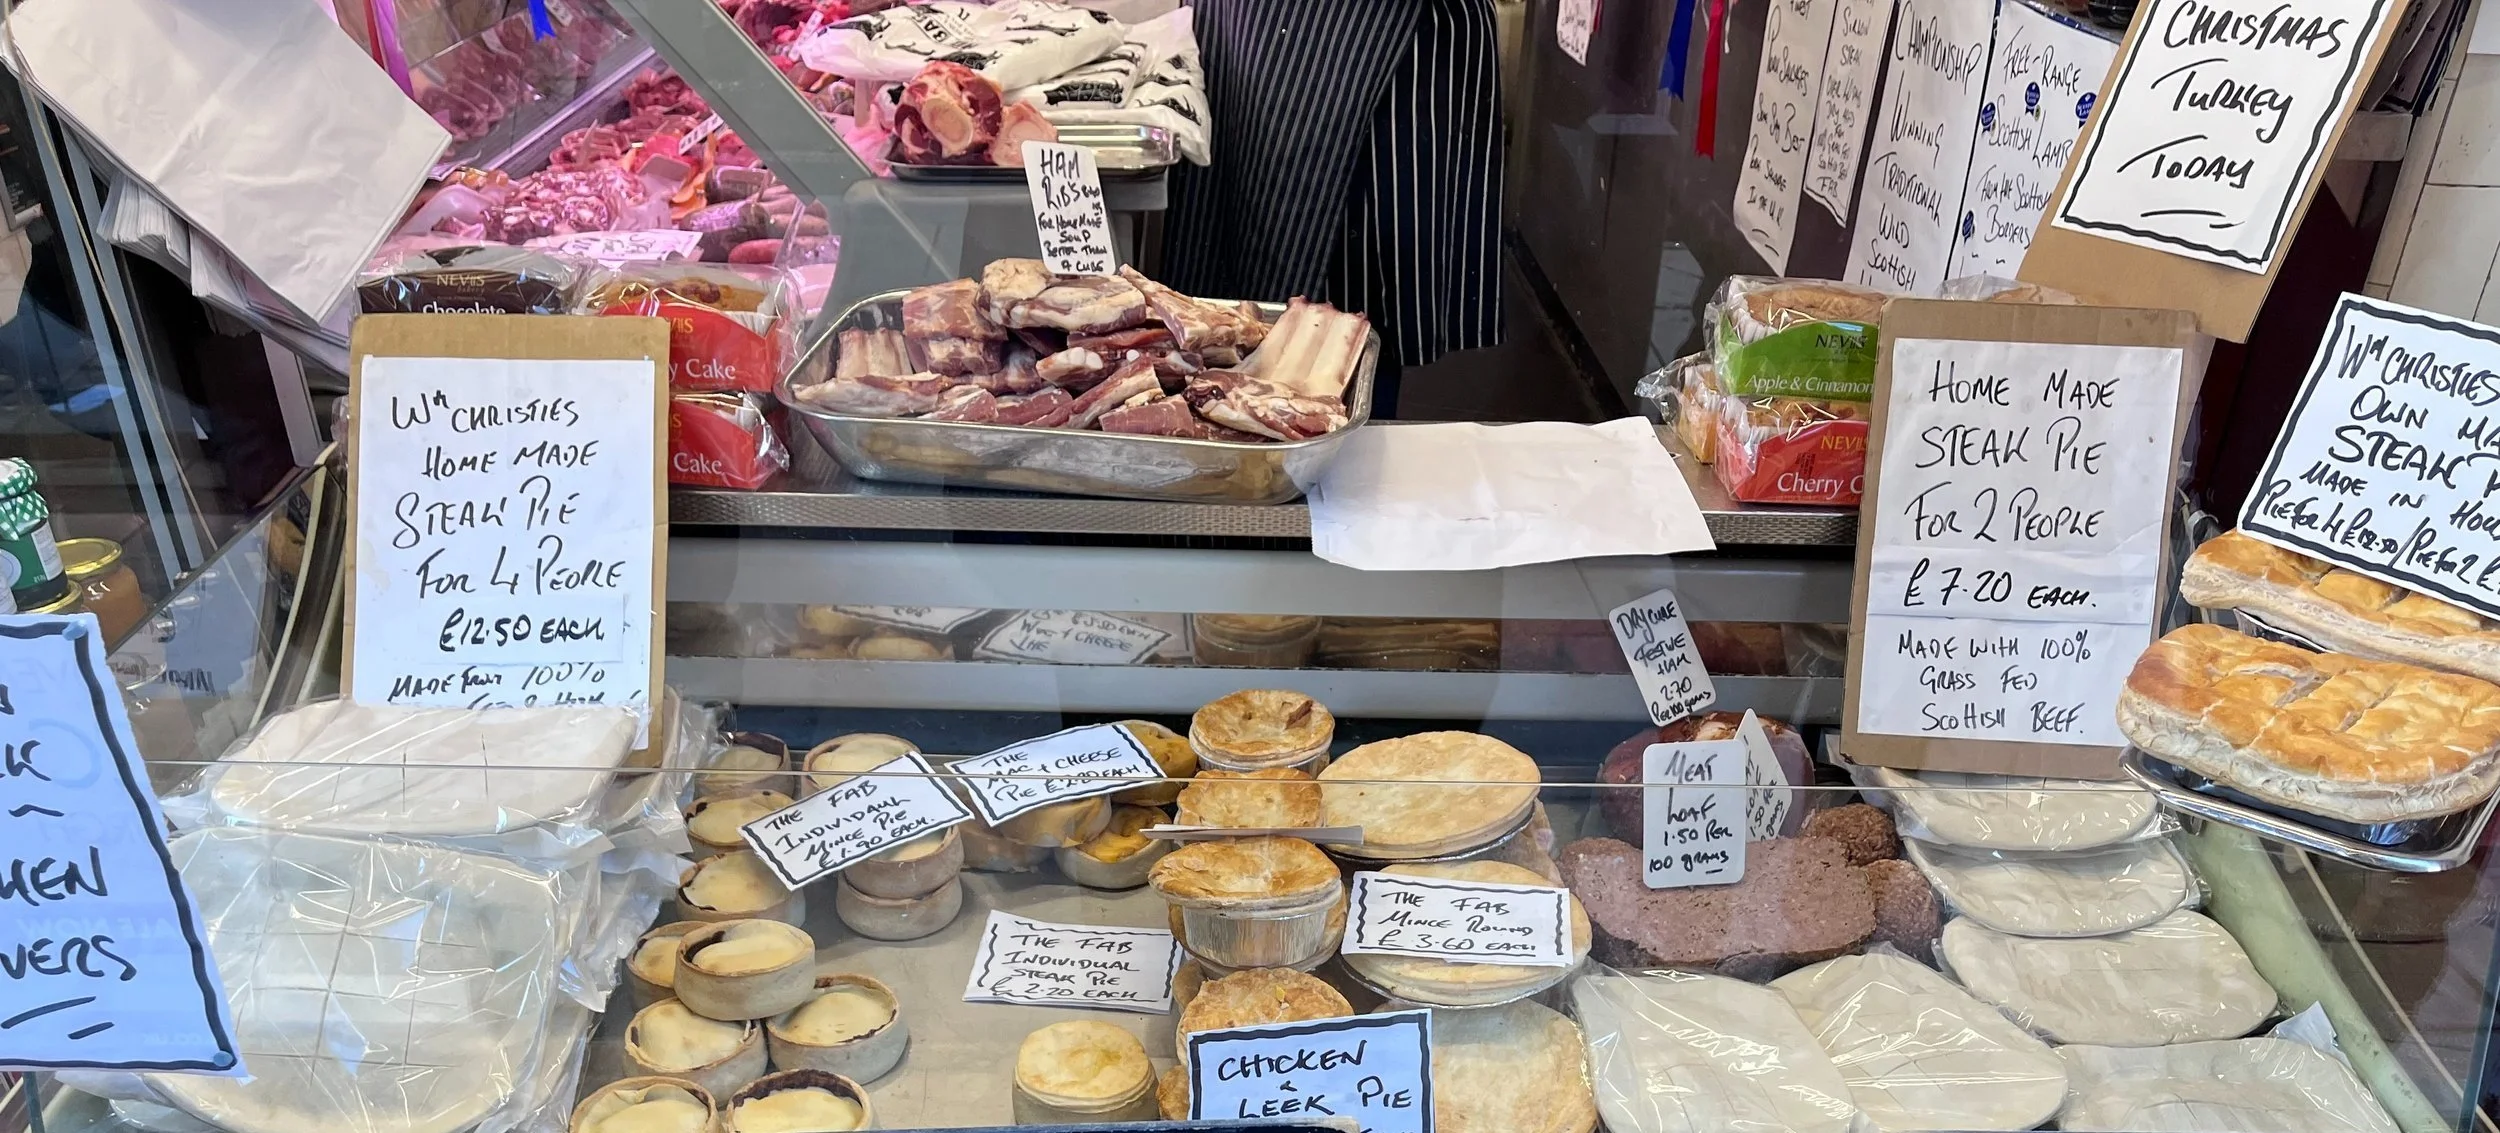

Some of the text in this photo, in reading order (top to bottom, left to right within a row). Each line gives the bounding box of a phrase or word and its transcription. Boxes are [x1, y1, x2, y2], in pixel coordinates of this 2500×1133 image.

[2164, 0, 2349, 58] CHRISTMAS
[1896, 4, 1983, 95] CHAMPIONSHIP
[1891, 70, 1944, 168] WINNING
[2150, 58, 2295, 143] TURKEY
[1988, 94, 2033, 152] SCOTTISH
[1040, 148, 1080, 179] HAM
[2116, 134, 2255, 189] TODAY
[1874, 152, 1941, 228] TRADITIONAL
[1059, 229, 1091, 244] SOUP
[1878, 203, 1910, 248] WILD
[1983, 205, 2031, 249] BORDERS
[1867, 239, 1916, 291] SCOTTISH
[685, 358, 737, 380] Cake
[1745, 374, 1788, 393] Apple
[1790, 374, 1803, 390] &
[1928, 359, 2121, 410] HOME MADE
[451, 397, 580, 433] CHRISTIES
[2350, 385, 2429, 429] OWN
[421, 440, 600, 481] HOME MADE
[673, 452, 723, 475] Cake
[1915, 415, 2108, 475] STEAK PIE
[2328, 424, 2466, 489] STEAK
[1777, 473, 1845, 500] Cherry
[2299, 461, 2368, 497] MADE
[2389, 492, 2426, 509] IN
[392, 474, 581, 550] STEAK PIE
[1903, 481, 2106, 542] FOR 2 PEOPLE
[416, 534, 626, 599] FOR 4 PEOPLE
[1617, 606, 1655, 644] DRY
[1898, 628, 2092, 663] MADE WITH 100%
[387, 673, 456, 703] MADE
[1660, 676, 1693, 702] 2.70
[1919, 664, 2038, 694] GRASS FED
[1921, 703, 2006, 731] SCOTTISH
[980, 751, 1029, 768] THE
[986, 763, 1034, 790] MAC
[1054, 746, 1123, 770] CHEESE
[1664, 750, 1718, 786] MEAT
[764, 779, 878, 831] THE FAB
[993, 783, 1038, 802] PIE
[1666, 786, 1717, 825] LOAF
[804, 809, 907, 862] MINCE PIE
[1663, 825, 1733, 847] 1.50 PER
[1649, 855, 1674, 874] 100
[1381, 891, 1511, 916] THE FAB
[1377, 910, 1534, 937] MINCE ROUND
[1001, 950, 1140, 972] INDIVIDUAL
[1010, 934, 1134, 955] THE FAB
[1011, 968, 1121, 986] STEAK PIE
[1083, 988, 1139, 999] EACH
[1217, 1039, 1367, 1082] CHICKEN
[1238, 1075, 1413, 1120] LEEK PIE
